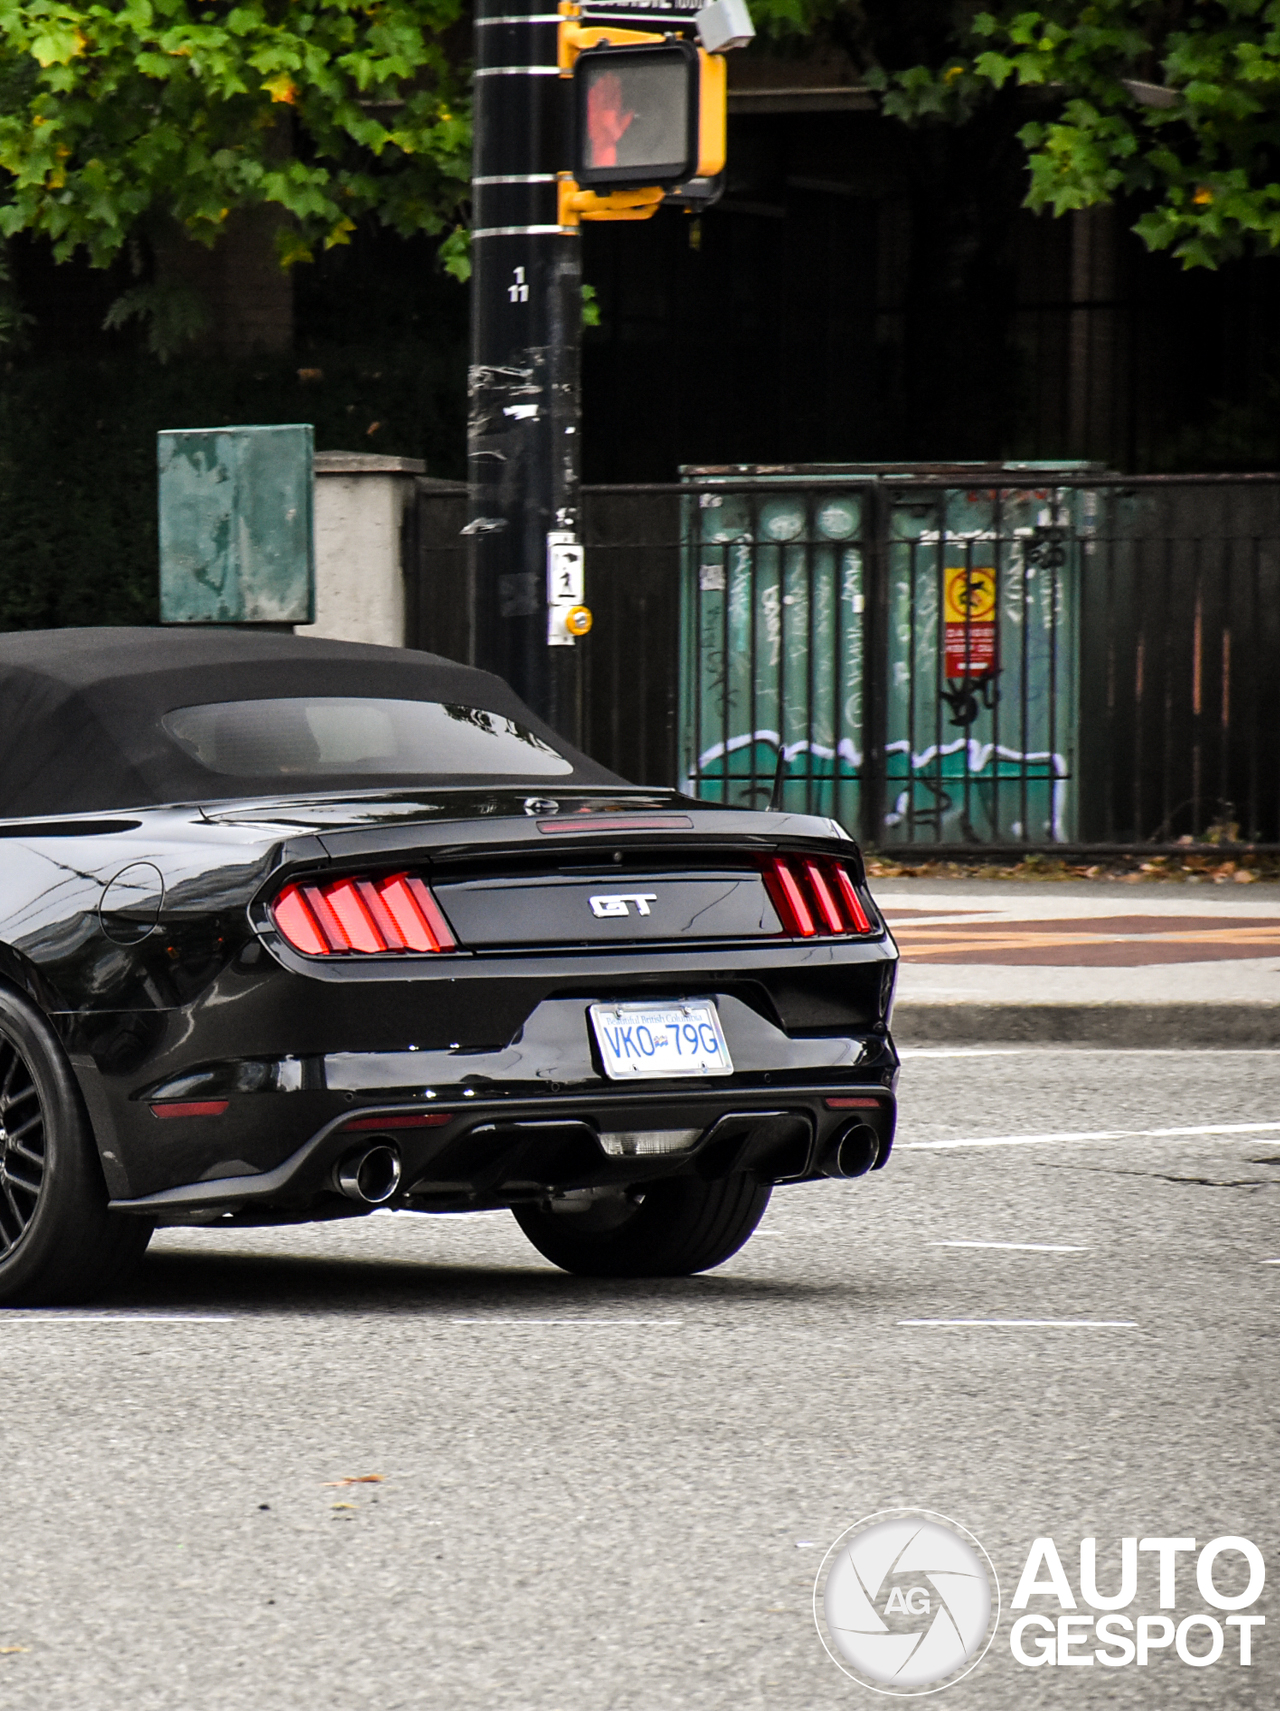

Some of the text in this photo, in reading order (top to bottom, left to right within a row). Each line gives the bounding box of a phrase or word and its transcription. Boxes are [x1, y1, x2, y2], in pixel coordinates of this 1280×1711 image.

[513, 266, 525, 284] 1
[507, 284, 530, 302] 11
[589, 894, 657, 917] GT
[605, 1013, 703, 1026] Beautiful British Columbia
[665, 1023, 719, 1056] 79G
